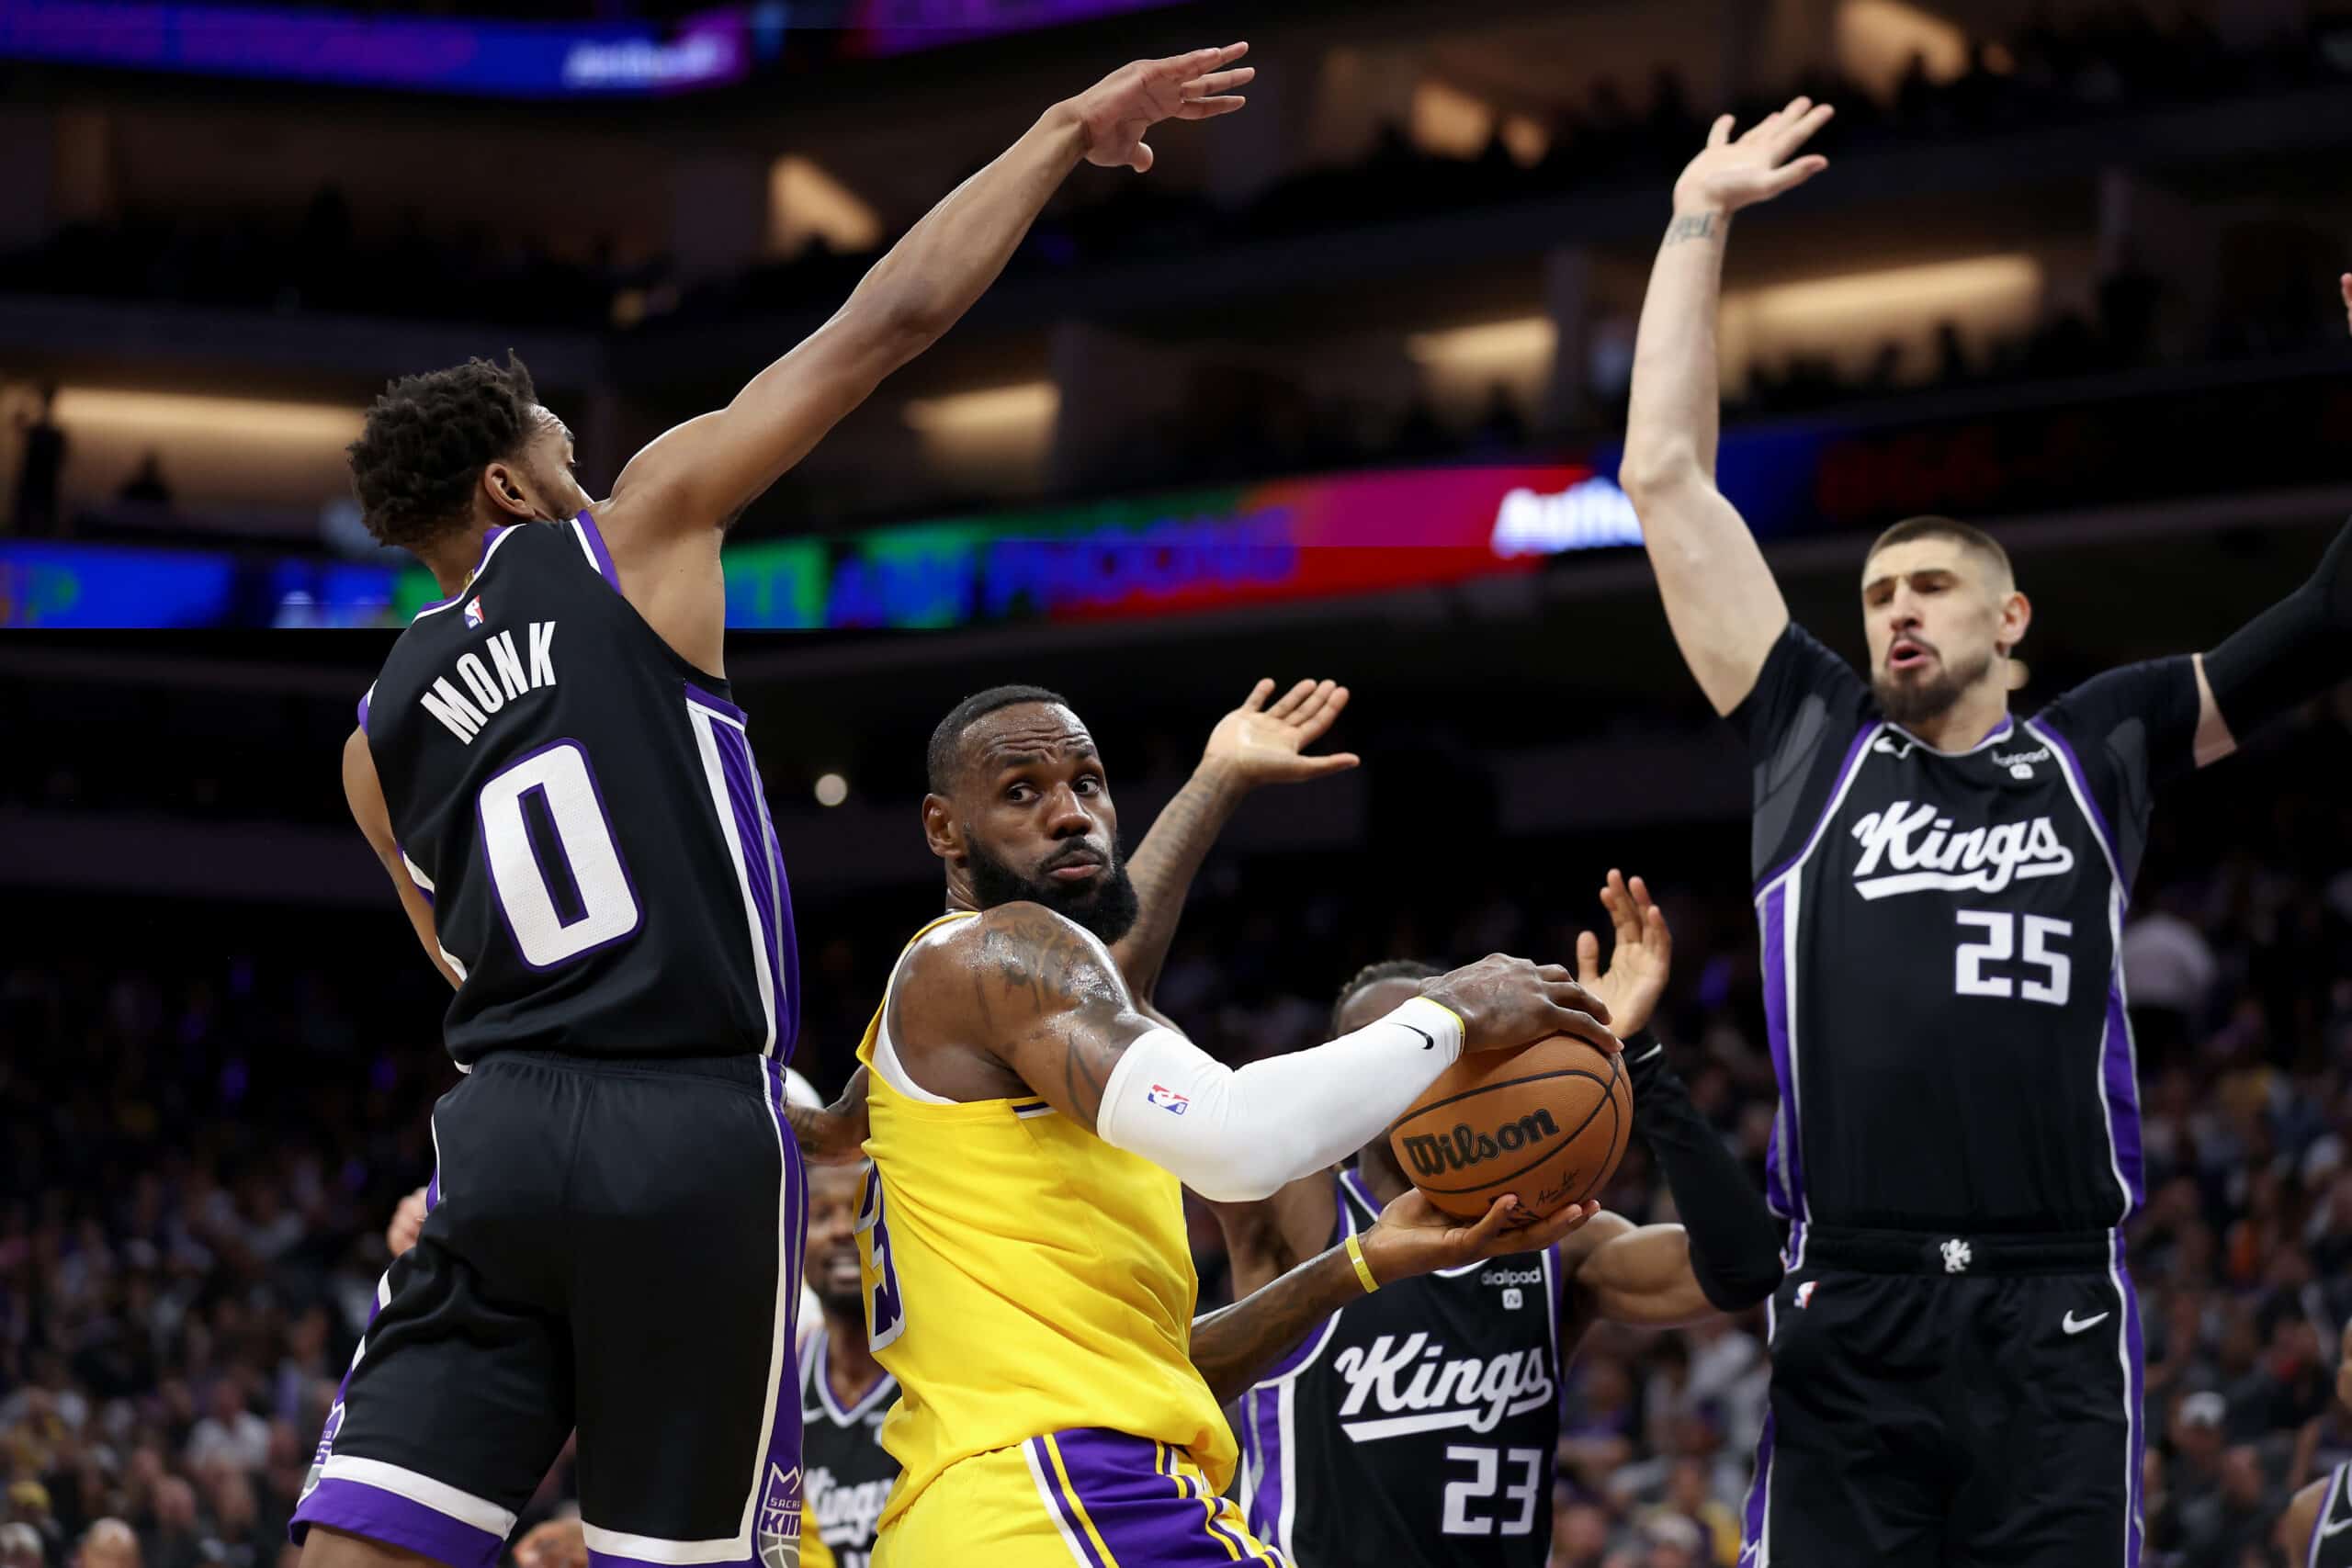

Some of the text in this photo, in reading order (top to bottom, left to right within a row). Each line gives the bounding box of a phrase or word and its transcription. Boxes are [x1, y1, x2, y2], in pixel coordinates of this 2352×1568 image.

[420, 621, 557, 746] MONK
[478, 741, 639, 968] 0
[1850, 801, 2074, 898] Kings
[1955, 908, 2073, 1006] 25
[1402, 1108, 1560, 1178] Wilson
[1480, 1266, 1543, 1287] dialpad
[1334, 1332, 1554, 1442] Kings
[1442, 1445, 1543, 1535] 23
